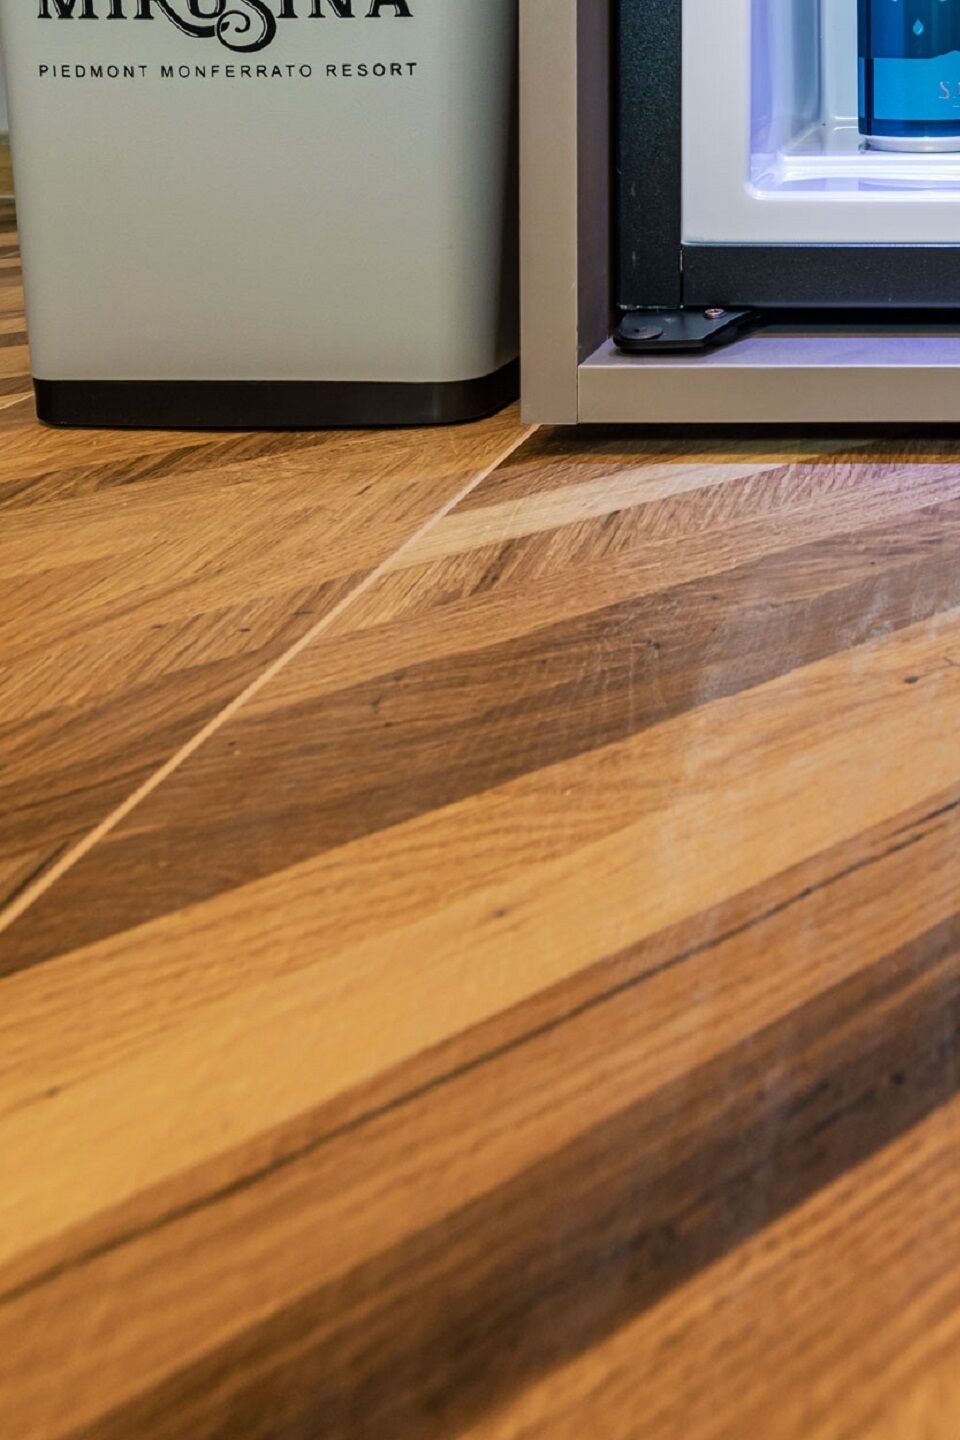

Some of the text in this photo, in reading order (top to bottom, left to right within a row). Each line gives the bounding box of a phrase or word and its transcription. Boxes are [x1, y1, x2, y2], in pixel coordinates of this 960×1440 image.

[39, 61, 418, 79] PIEDMONT MONFERRATO RESORT
